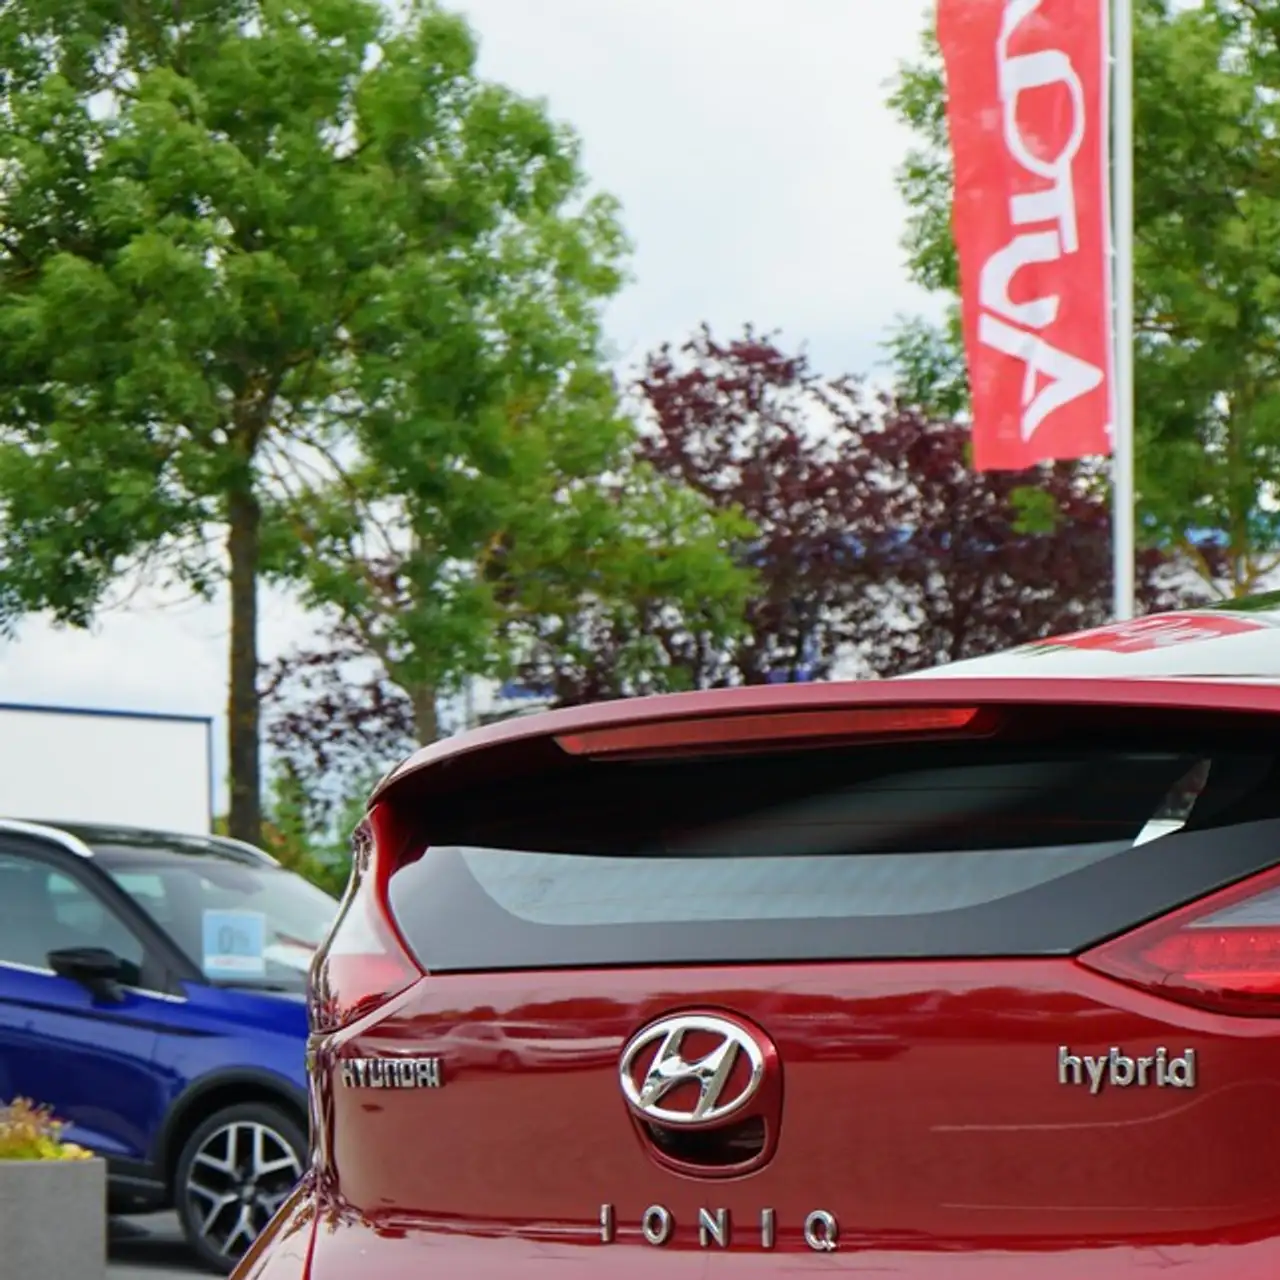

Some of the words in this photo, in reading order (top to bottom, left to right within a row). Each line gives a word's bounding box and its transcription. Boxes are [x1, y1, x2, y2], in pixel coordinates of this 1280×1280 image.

[341, 1056, 443, 1089] HYUNDAI
[1058, 1045, 1196, 1094] hybrid
[598, 1203, 839, 1252] IONIQ
